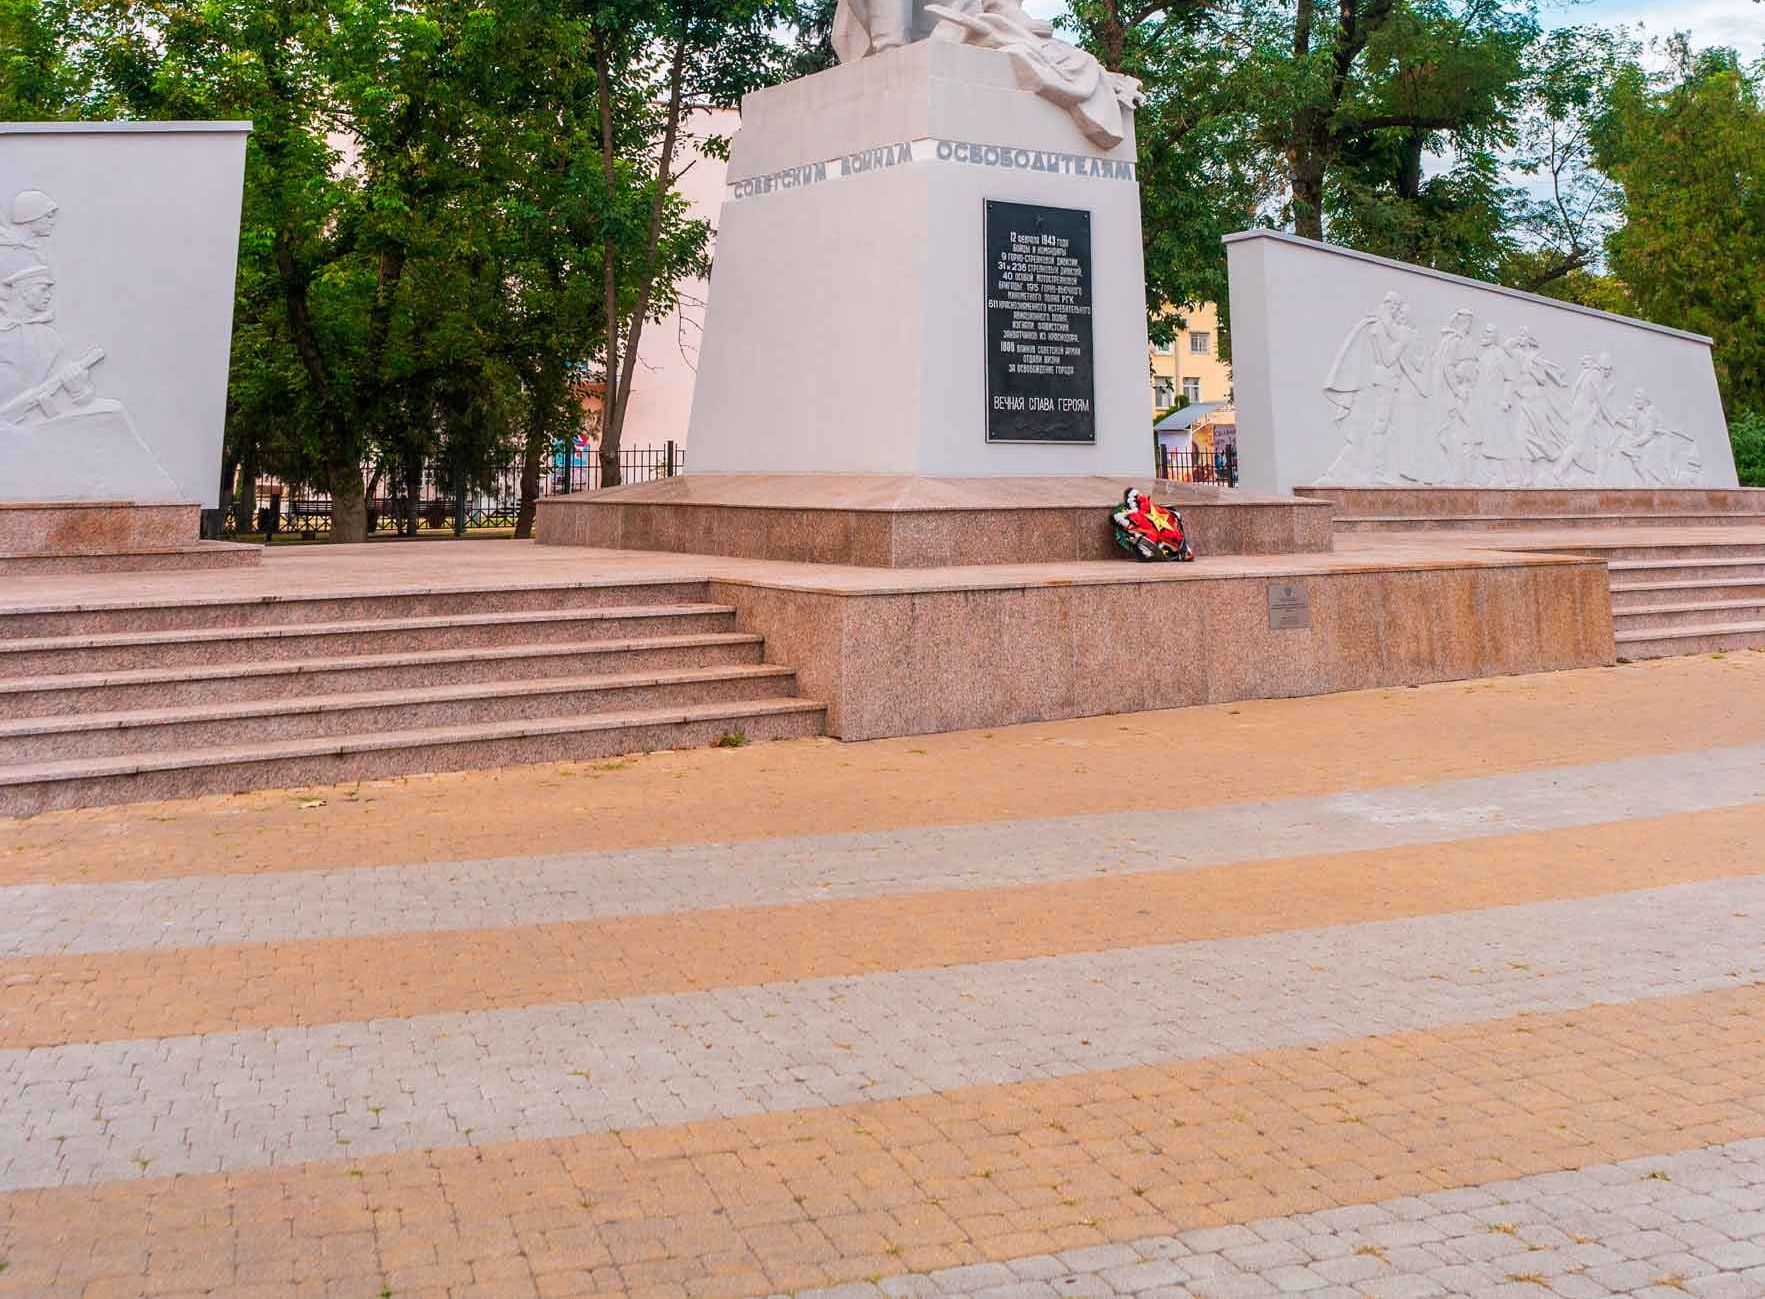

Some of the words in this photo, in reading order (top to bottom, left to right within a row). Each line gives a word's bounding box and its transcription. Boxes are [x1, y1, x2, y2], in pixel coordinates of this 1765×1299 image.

[936, 141, 1134, 180] ОСВОБОДИТЕЛЯМ
[1010, 231, 1017, 242] 12
[1041, 234, 1056, 246] 1943
[998, 262, 1006, 270] 31
[1003, 272, 1013, 280] 40
[1026, 283, 1039, 292] 195
[988, 299, 998, 308] 611
[1061, 295, 1074, 304] РГК
[993, 396, 1025, 410] ВЕЧНАЯ
[1028, 397, 1054, 411] СЛАВА
[1058, 398, 1090, 412] ГЕРОЯМ
